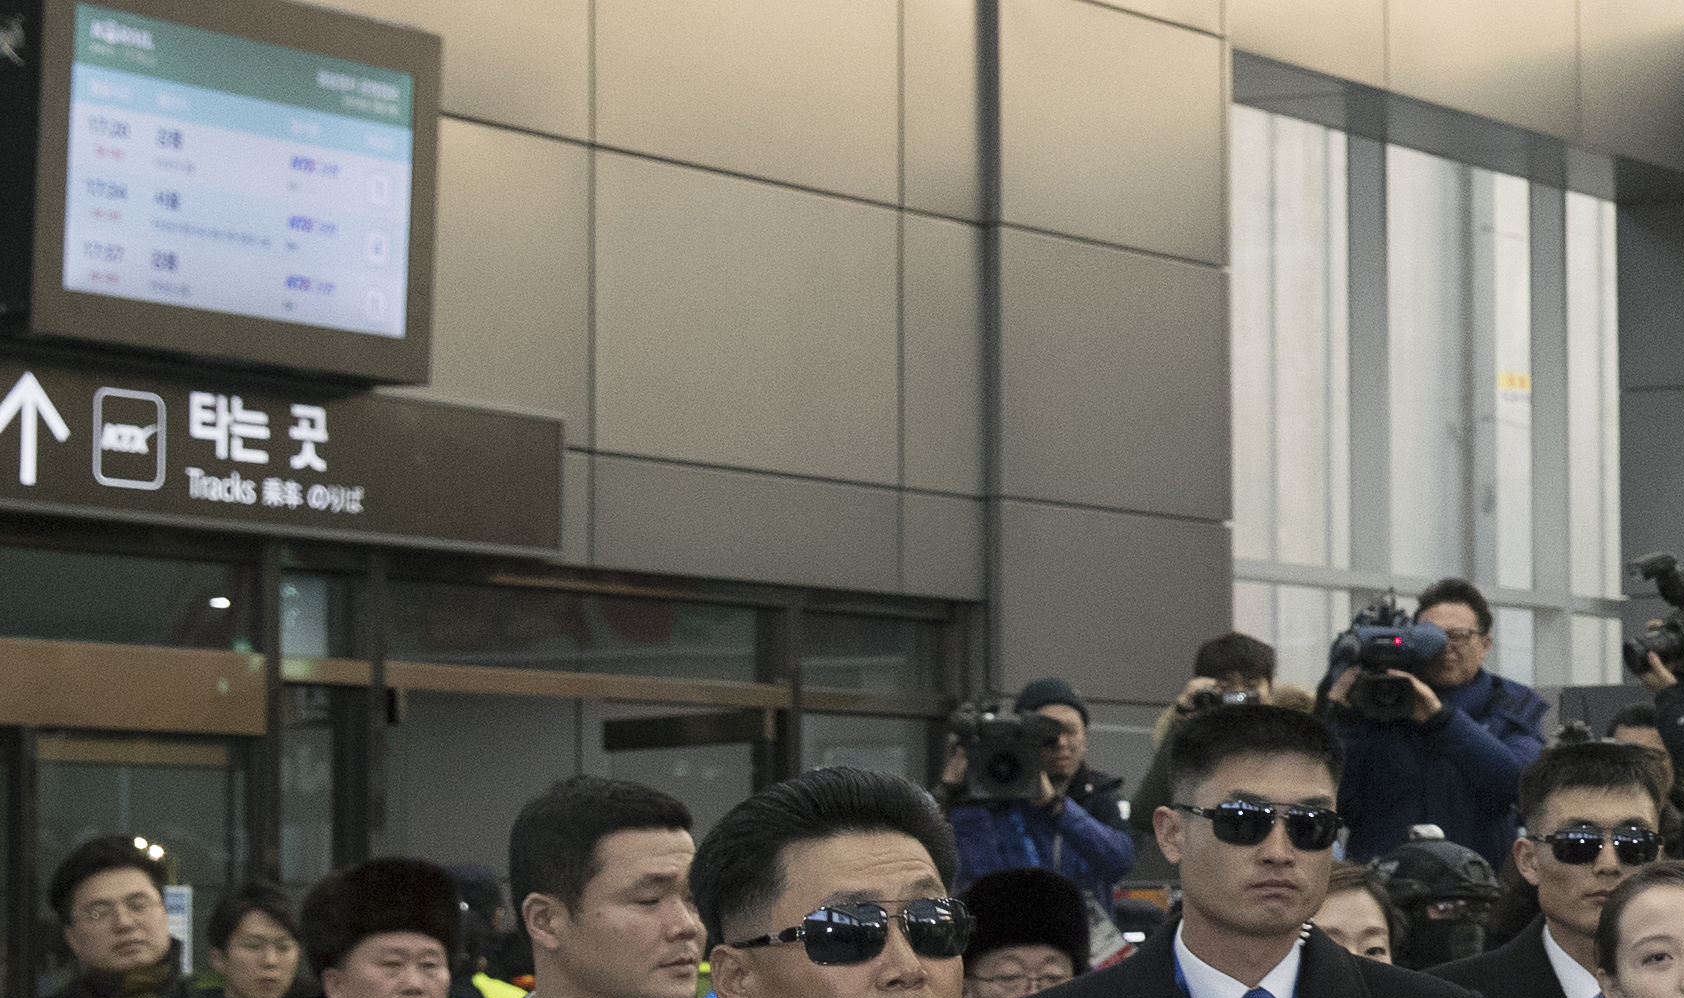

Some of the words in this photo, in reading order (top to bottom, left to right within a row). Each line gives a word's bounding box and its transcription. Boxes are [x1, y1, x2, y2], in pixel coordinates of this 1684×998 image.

[189, 390, 271, 464] 타는
[288, 403, 329, 473] 곳
[185, 466, 257, 505] Tracks
[306, 484, 365, 514] のりば
